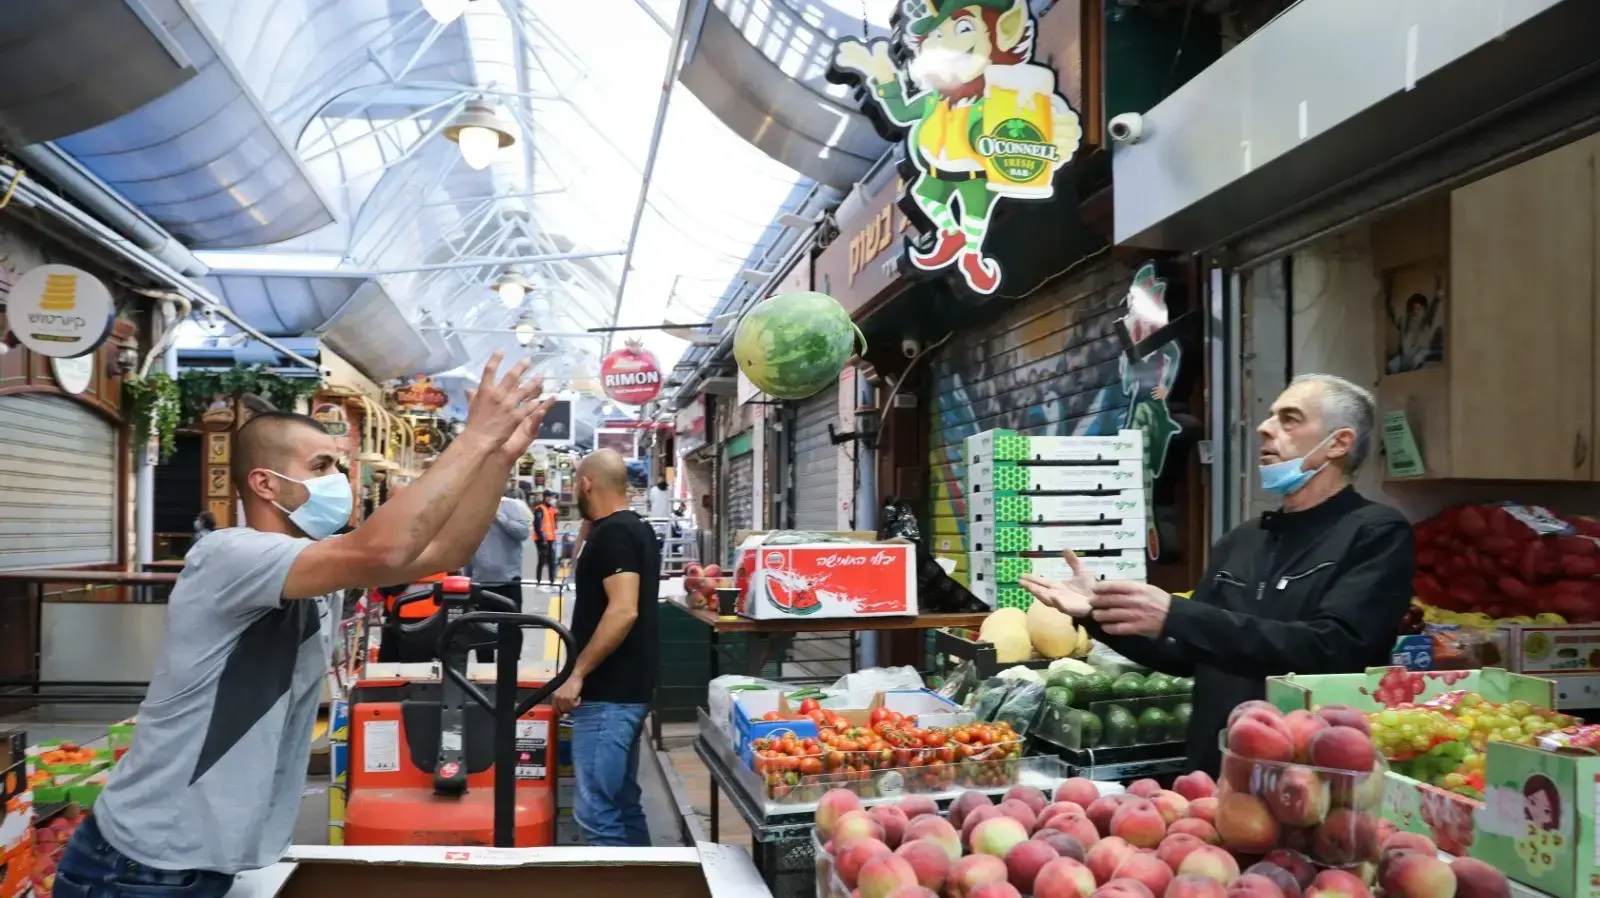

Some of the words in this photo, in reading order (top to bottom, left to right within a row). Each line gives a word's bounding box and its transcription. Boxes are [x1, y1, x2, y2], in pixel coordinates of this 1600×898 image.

[979, 137, 1059, 160] O'CONNELL
[1004, 159, 1035, 170] IRISH
[848, 202, 892, 288] בשוק
[605, 371, 659, 387] RIMON
